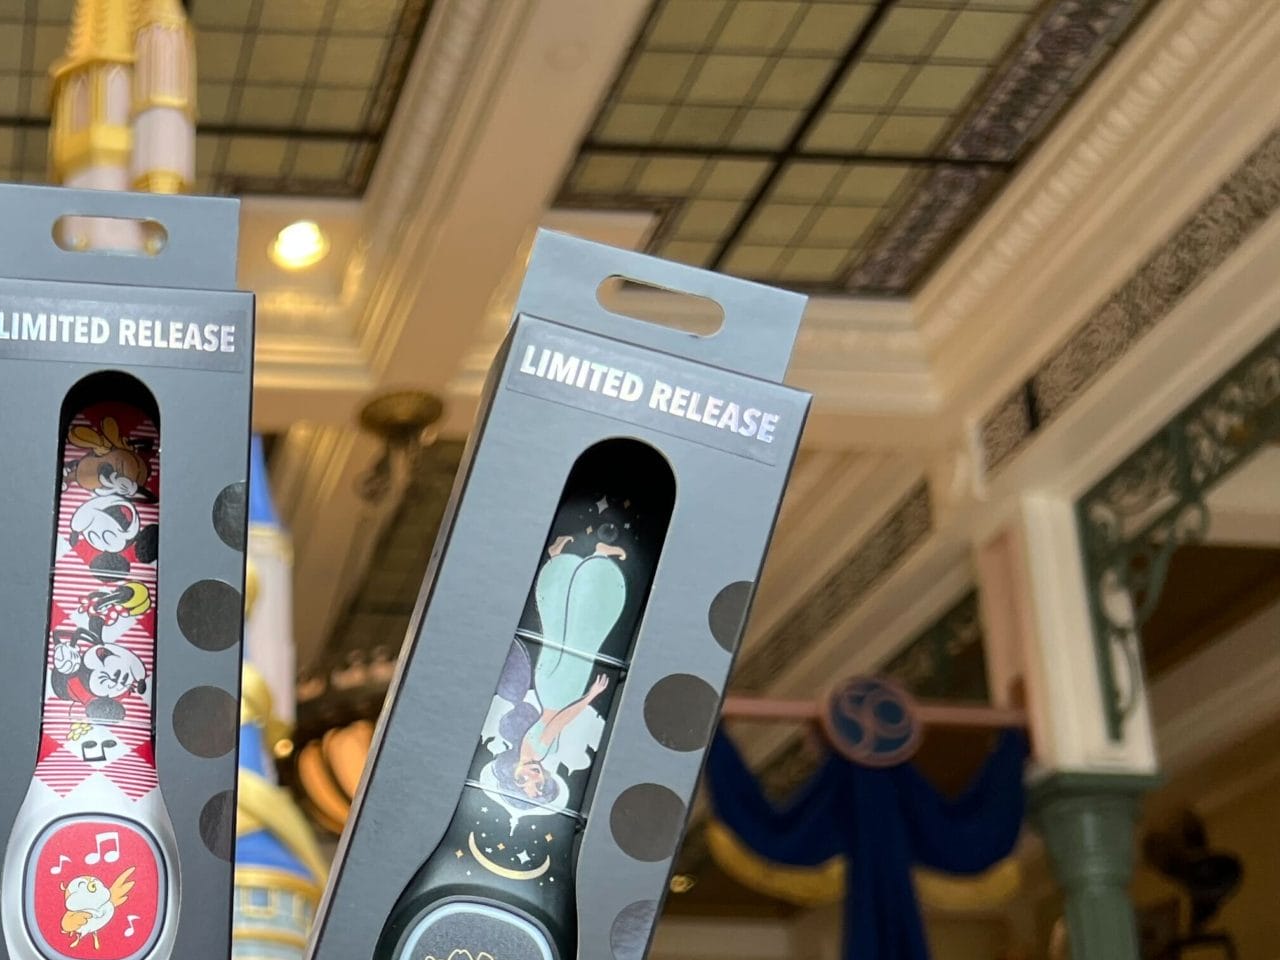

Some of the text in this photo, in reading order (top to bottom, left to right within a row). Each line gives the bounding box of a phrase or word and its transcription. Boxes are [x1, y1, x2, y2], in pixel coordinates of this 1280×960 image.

[118, 319, 236, 353] RELEASE
[519, 344, 781, 443] LIMITED RELEASE
